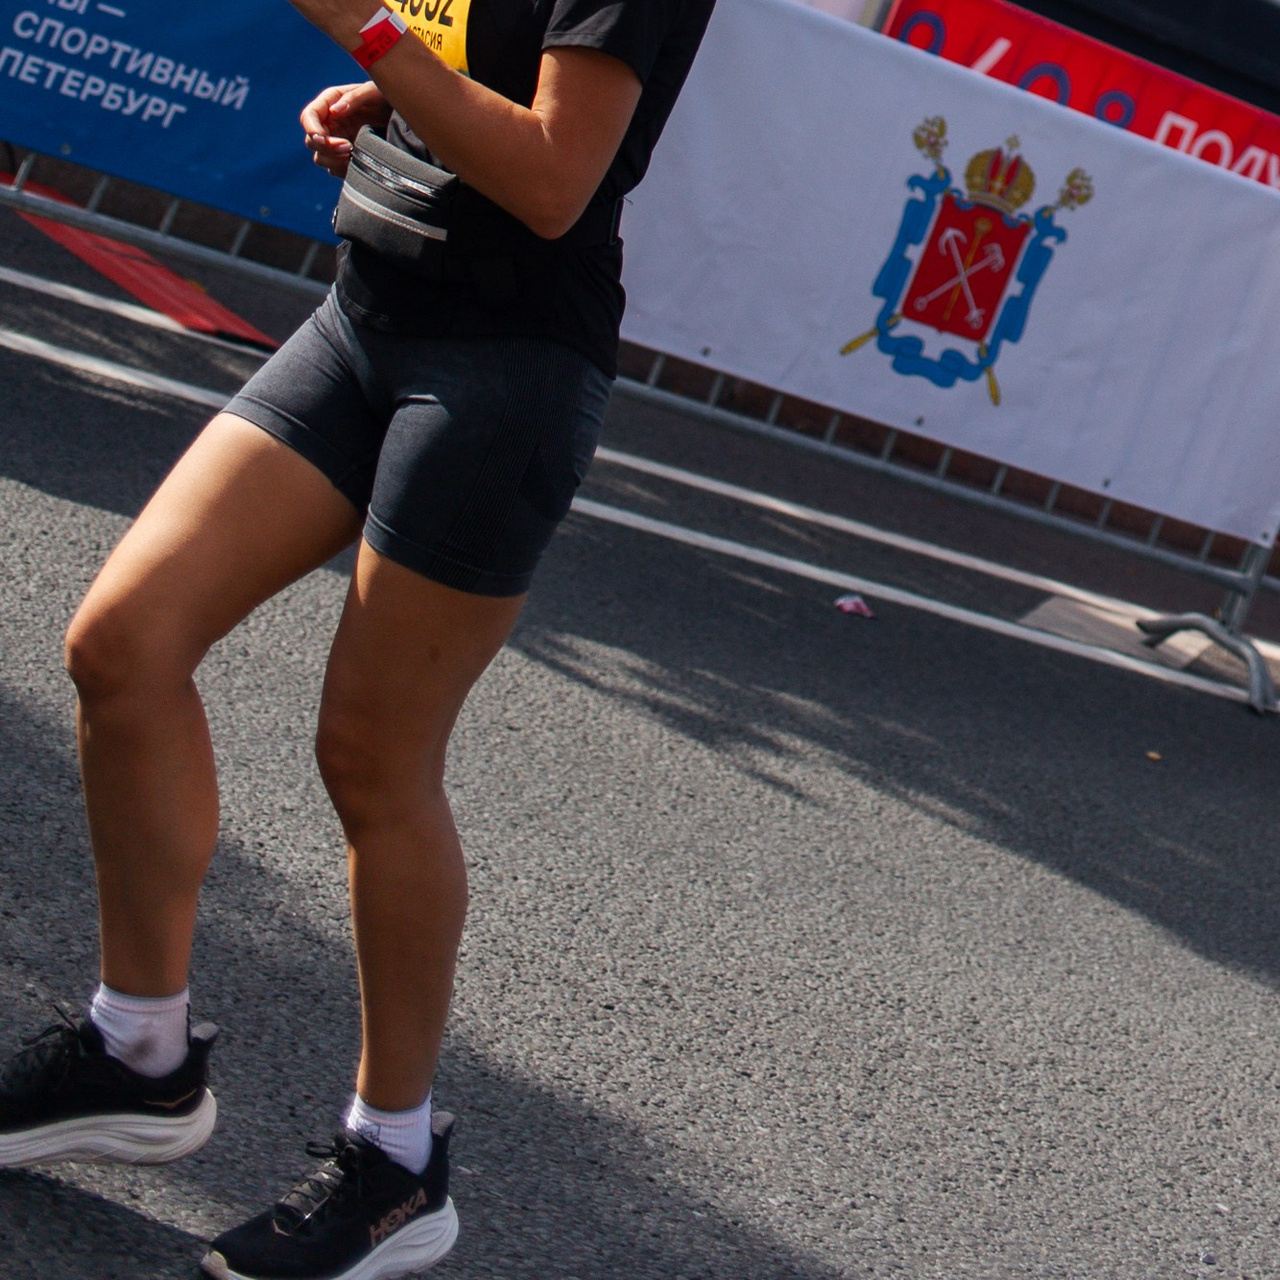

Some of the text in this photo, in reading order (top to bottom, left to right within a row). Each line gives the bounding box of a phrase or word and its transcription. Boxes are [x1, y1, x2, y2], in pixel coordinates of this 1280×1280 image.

[0, 46, 188, 129] ПЕТЕРБУРГ
[13, 10, 250, 110] СПОРТИВНЫЙ
[369, 1186, 428, 1248] HOKA
